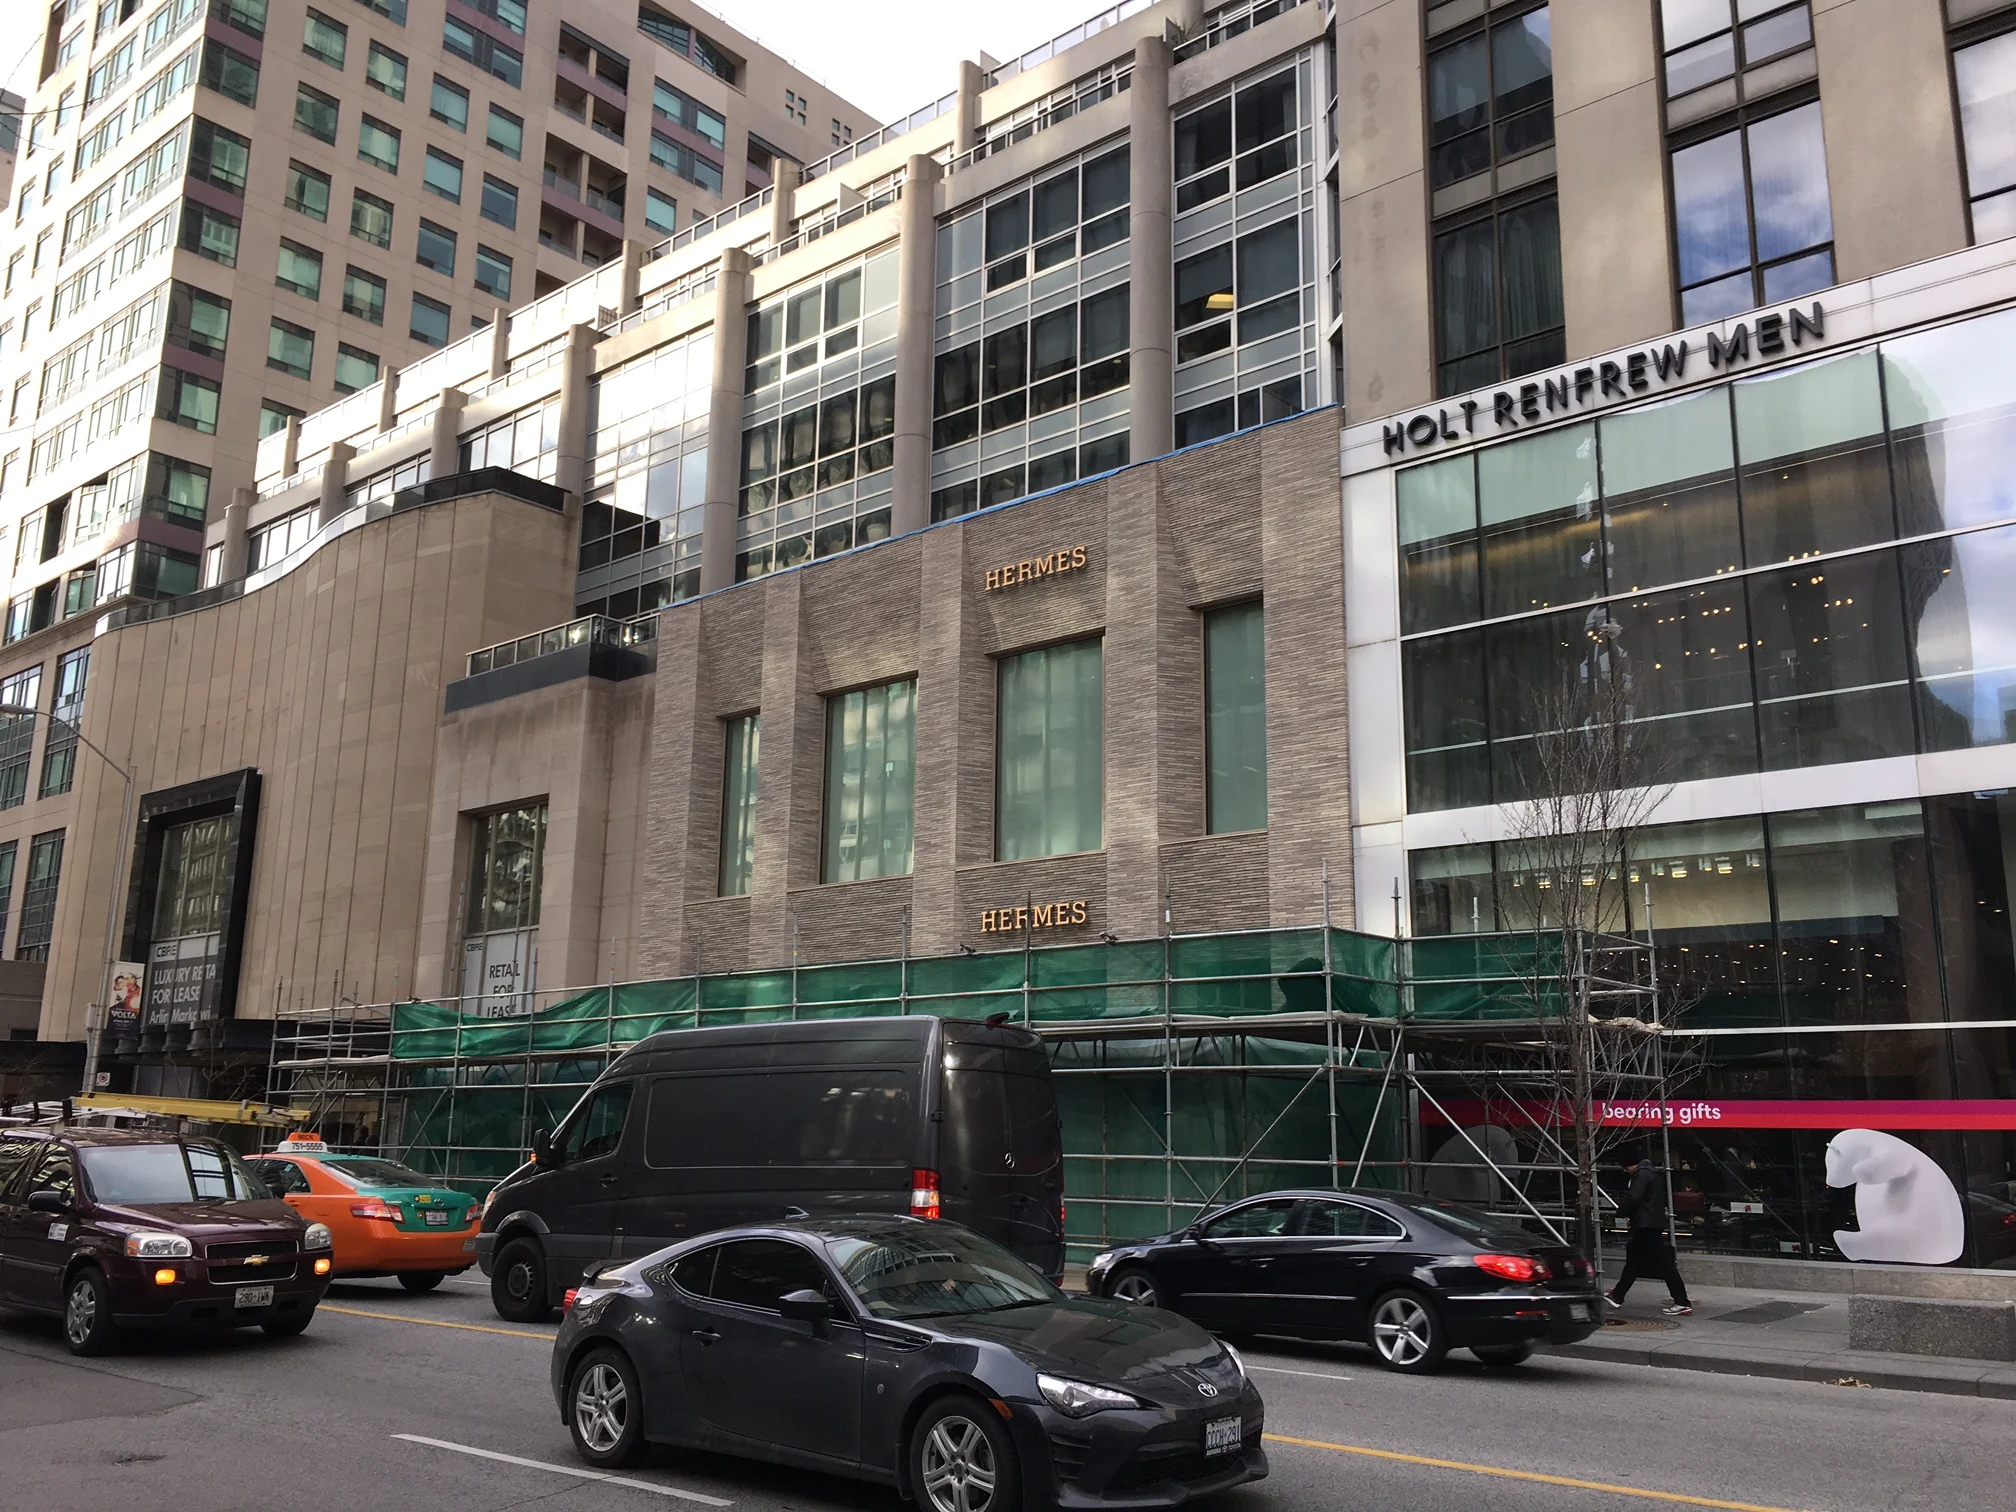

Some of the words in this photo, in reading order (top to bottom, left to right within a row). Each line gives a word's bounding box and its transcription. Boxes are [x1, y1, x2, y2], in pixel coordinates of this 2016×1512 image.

[1382, 400, 1478, 455] HOLT
[1494, 340, 1687, 427] RENFREW
[1707, 301, 1824, 367] MEN
[156, 945, 177, 957] CBRE
[151, 988, 171, 1004] FOR
[173, 985, 201, 1003] LEASE
[111, 1010, 136, 1019] VOLTA
[1602, 1102, 1674, 1125] bearing
[1679, 1102, 1722, 1125] gifts
[291, 1142, 324, 1151] 751-5555
